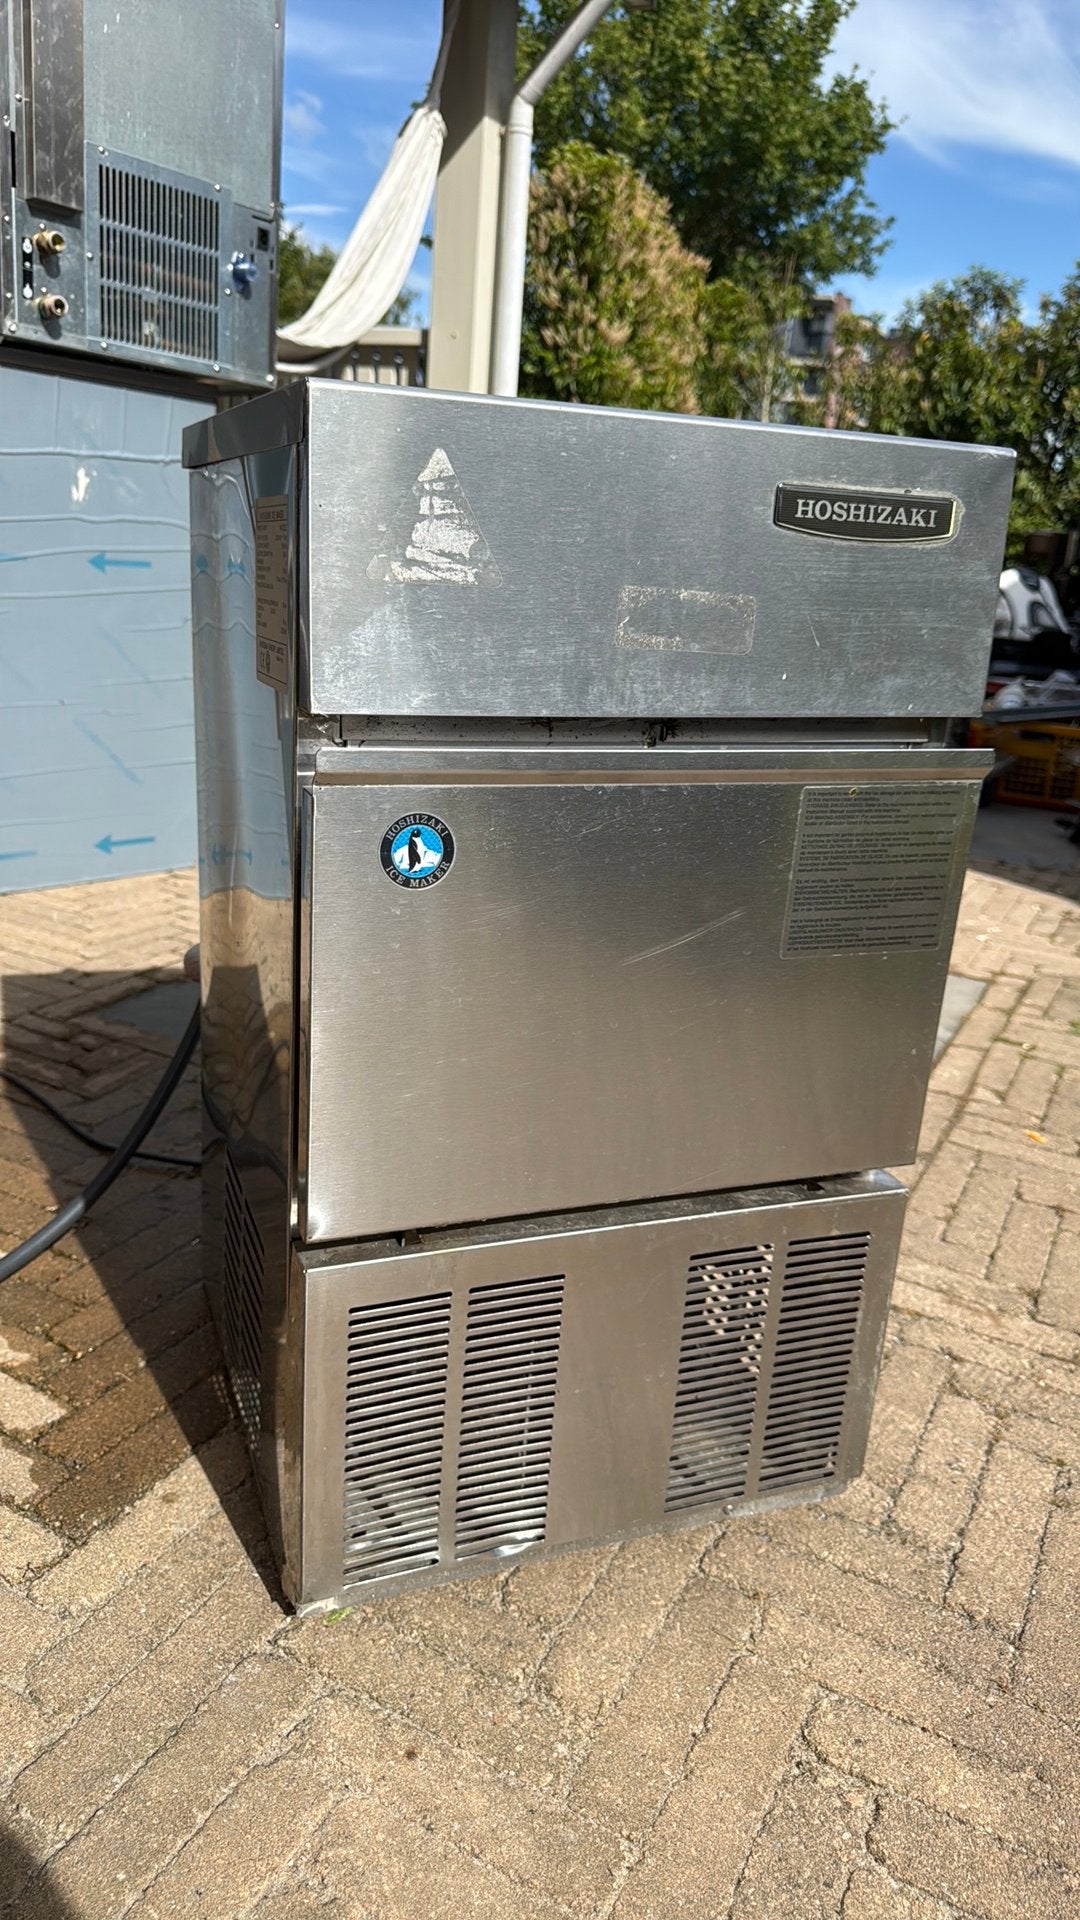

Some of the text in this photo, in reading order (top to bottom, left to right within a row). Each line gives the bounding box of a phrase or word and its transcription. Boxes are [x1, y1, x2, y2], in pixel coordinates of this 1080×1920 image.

[795, 499, 937, 528] HOSHIZAKI
[386, 815, 448, 840] HOSHIZAKI
[386, 861, 449, 887] ICE MAKER
